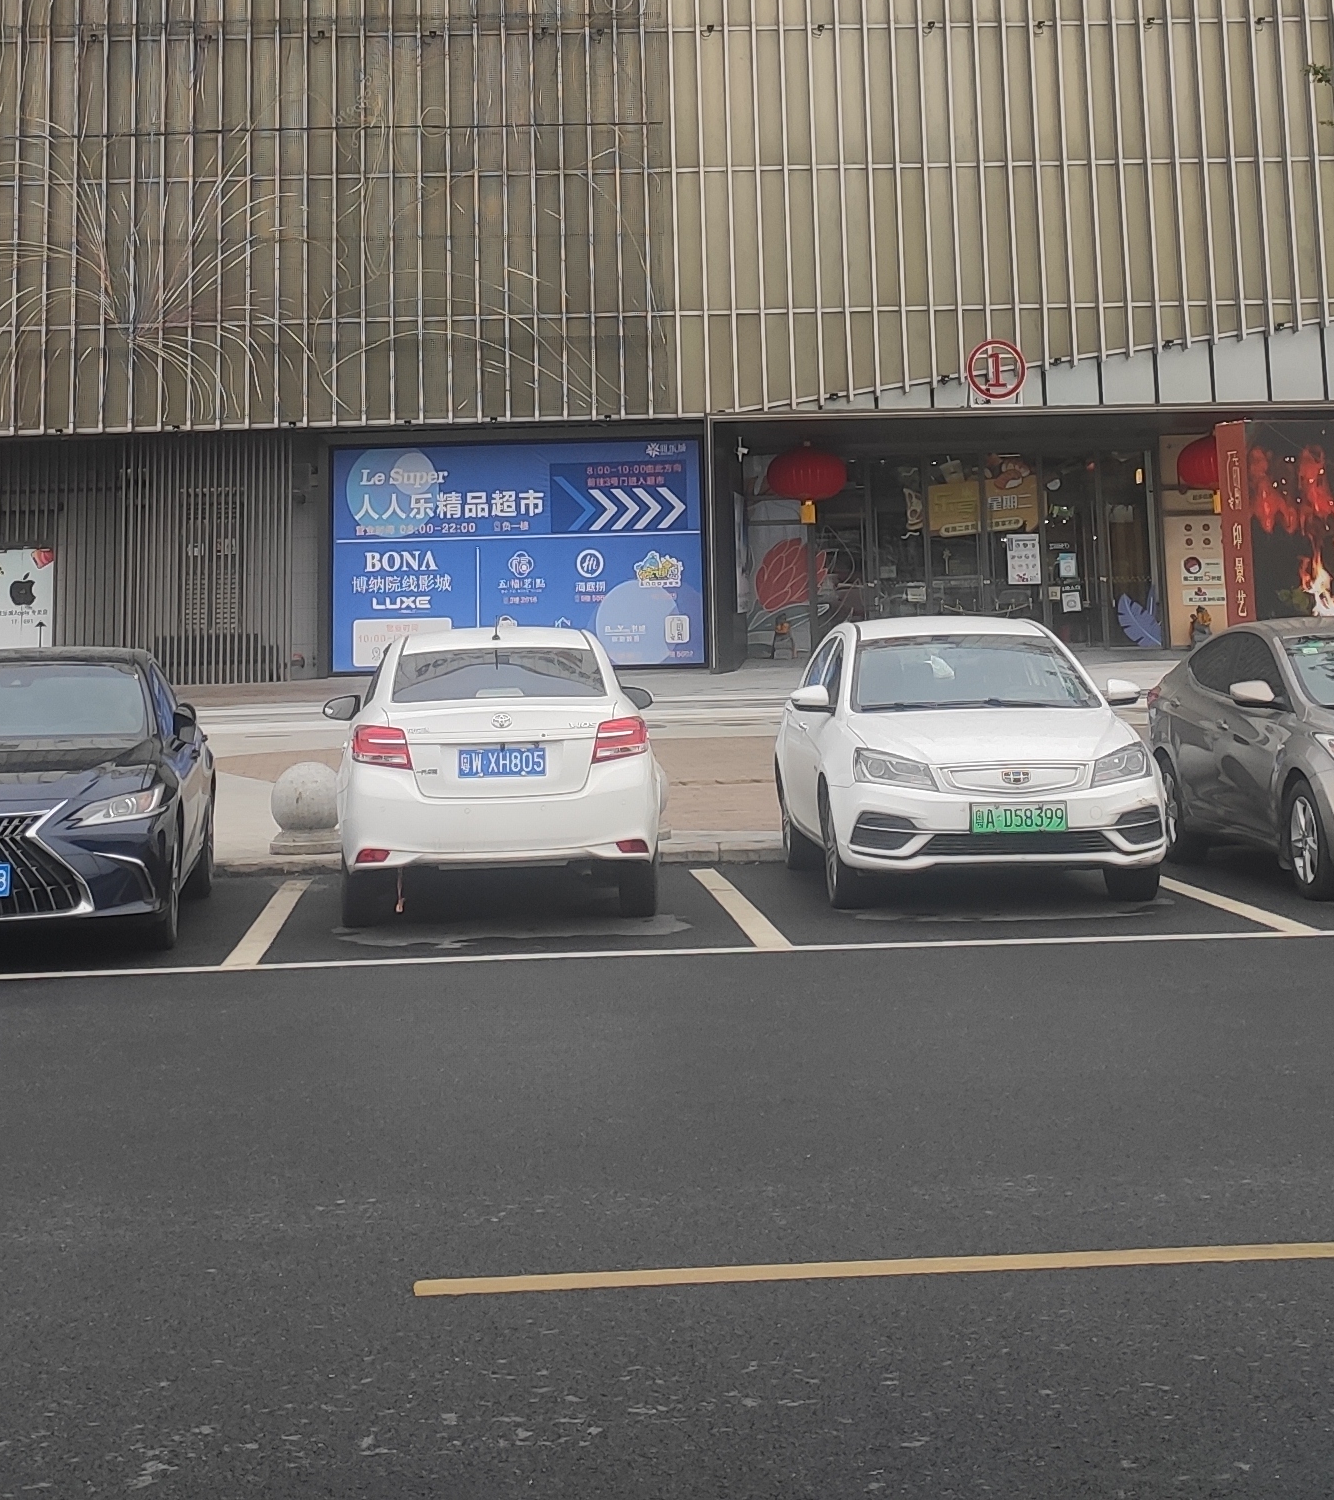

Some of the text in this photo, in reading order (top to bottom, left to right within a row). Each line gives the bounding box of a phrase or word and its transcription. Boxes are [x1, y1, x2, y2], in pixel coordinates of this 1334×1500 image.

[359, 467, 449, 489] Le Super
[354, 489, 545, 520] 人人乐精品超市
[988, 494, 1033, 511] 星期二
[364, 551, 439, 572] BONA
[352, 573, 452, 594] 博纳院线影城
[372, 595, 432, 610] LUXE
